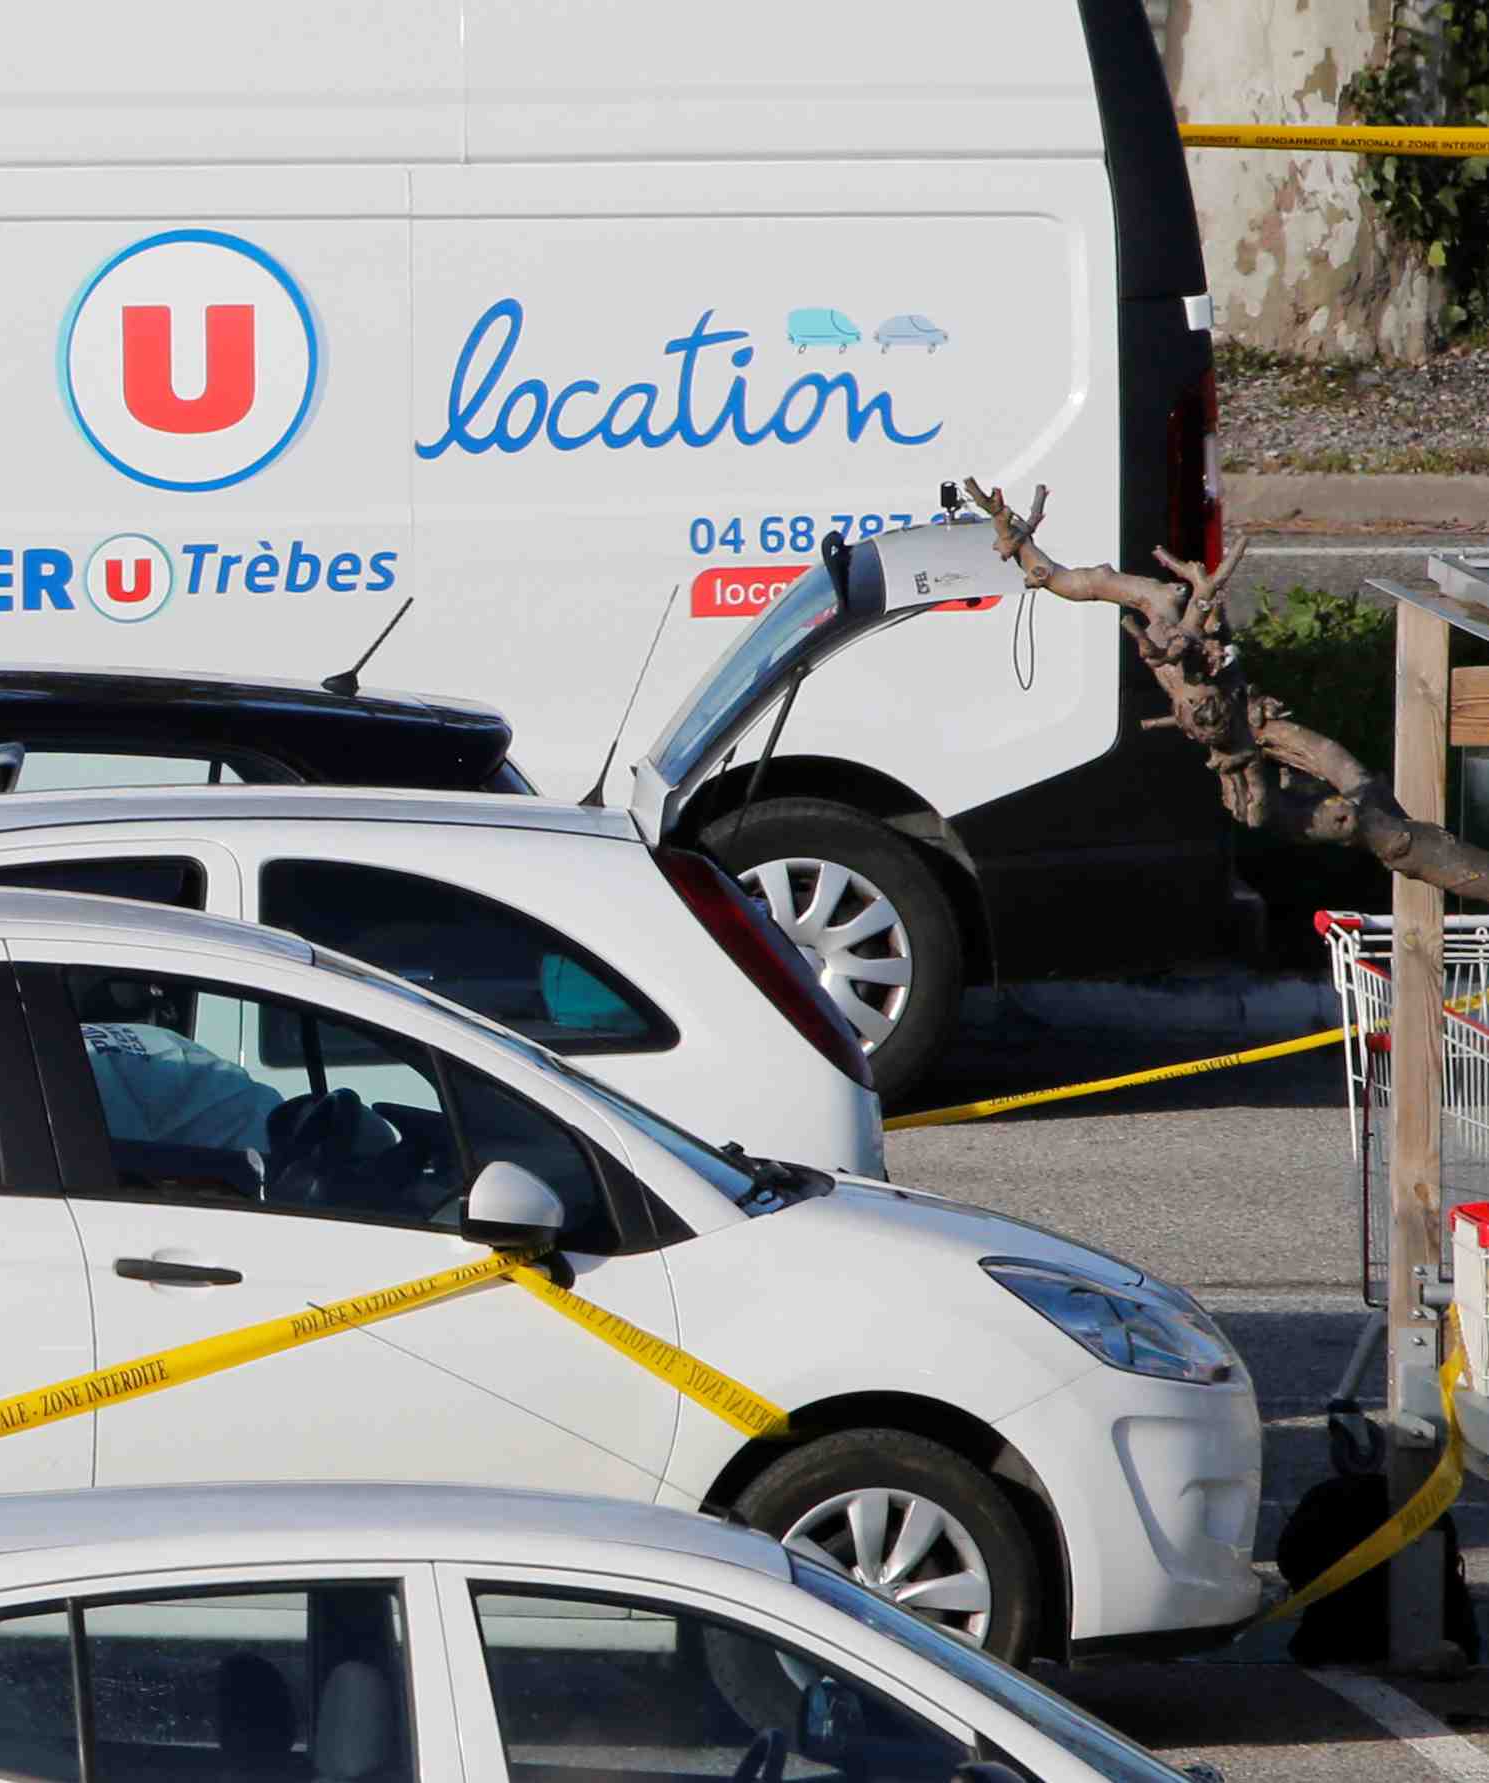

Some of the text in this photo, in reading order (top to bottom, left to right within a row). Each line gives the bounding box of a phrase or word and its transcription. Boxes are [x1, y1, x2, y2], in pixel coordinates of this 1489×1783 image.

[1341, 137, 1404, 148] NATIONALE
[1408, 139, 1440, 150] ZONE
[122, 304, 256, 434] U
[415, 298, 944, 459] location
[689, 517, 746, 555] 04
[759, 515, 815, 554] 68
[105, 558, 153, 603] U
[182, 540, 398, 595] Trèbes
[291, 1308, 348, 1339] POLICE
[39, 1385, 84, 1417] ZONE
[84, 1358, 170, 1403] INTERDITE
